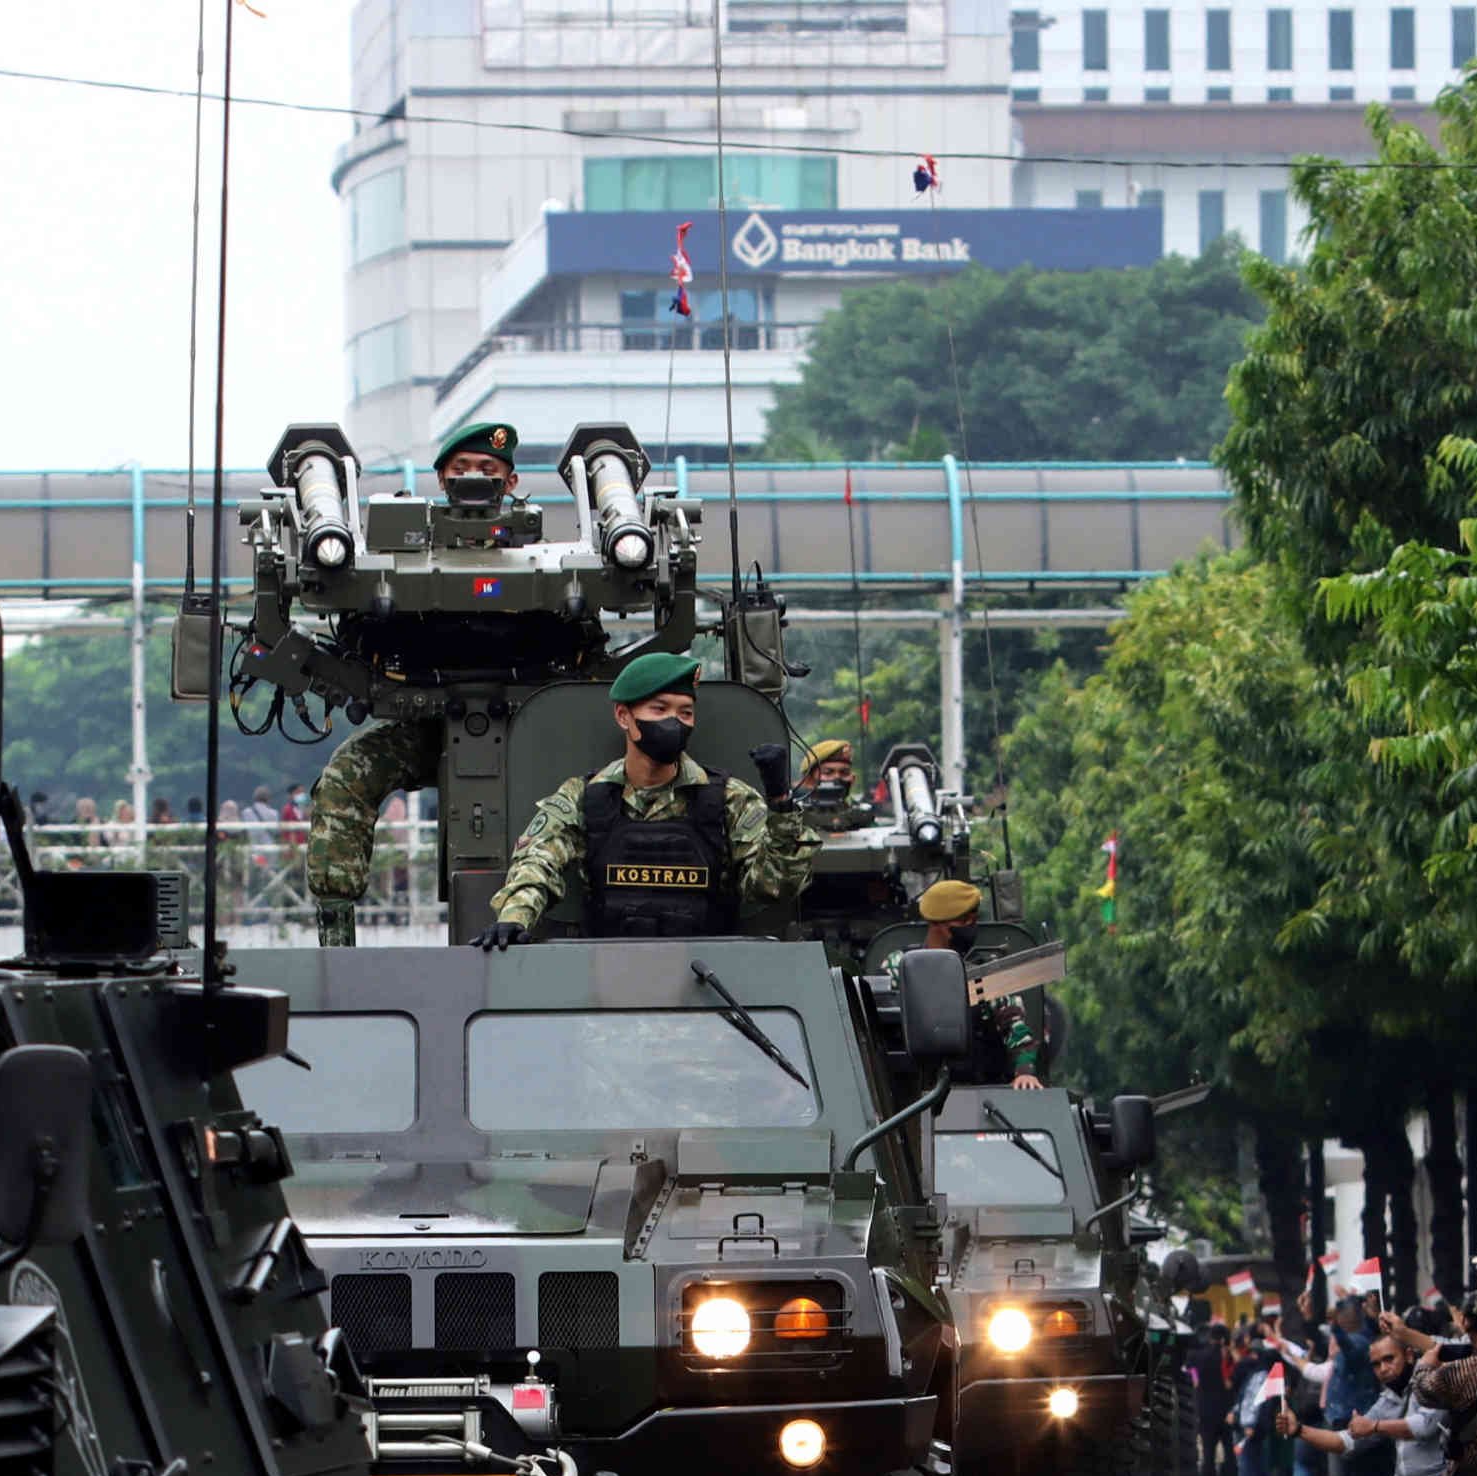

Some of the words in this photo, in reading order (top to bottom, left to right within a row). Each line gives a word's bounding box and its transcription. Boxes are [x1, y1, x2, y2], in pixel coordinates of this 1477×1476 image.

[781, 238, 896, 266] Bangkok
[901, 238, 970, 262] Bank
[616, 869, 699, 884] KOSTRAD
[359, 1250, 487, 1270] KOMODO
